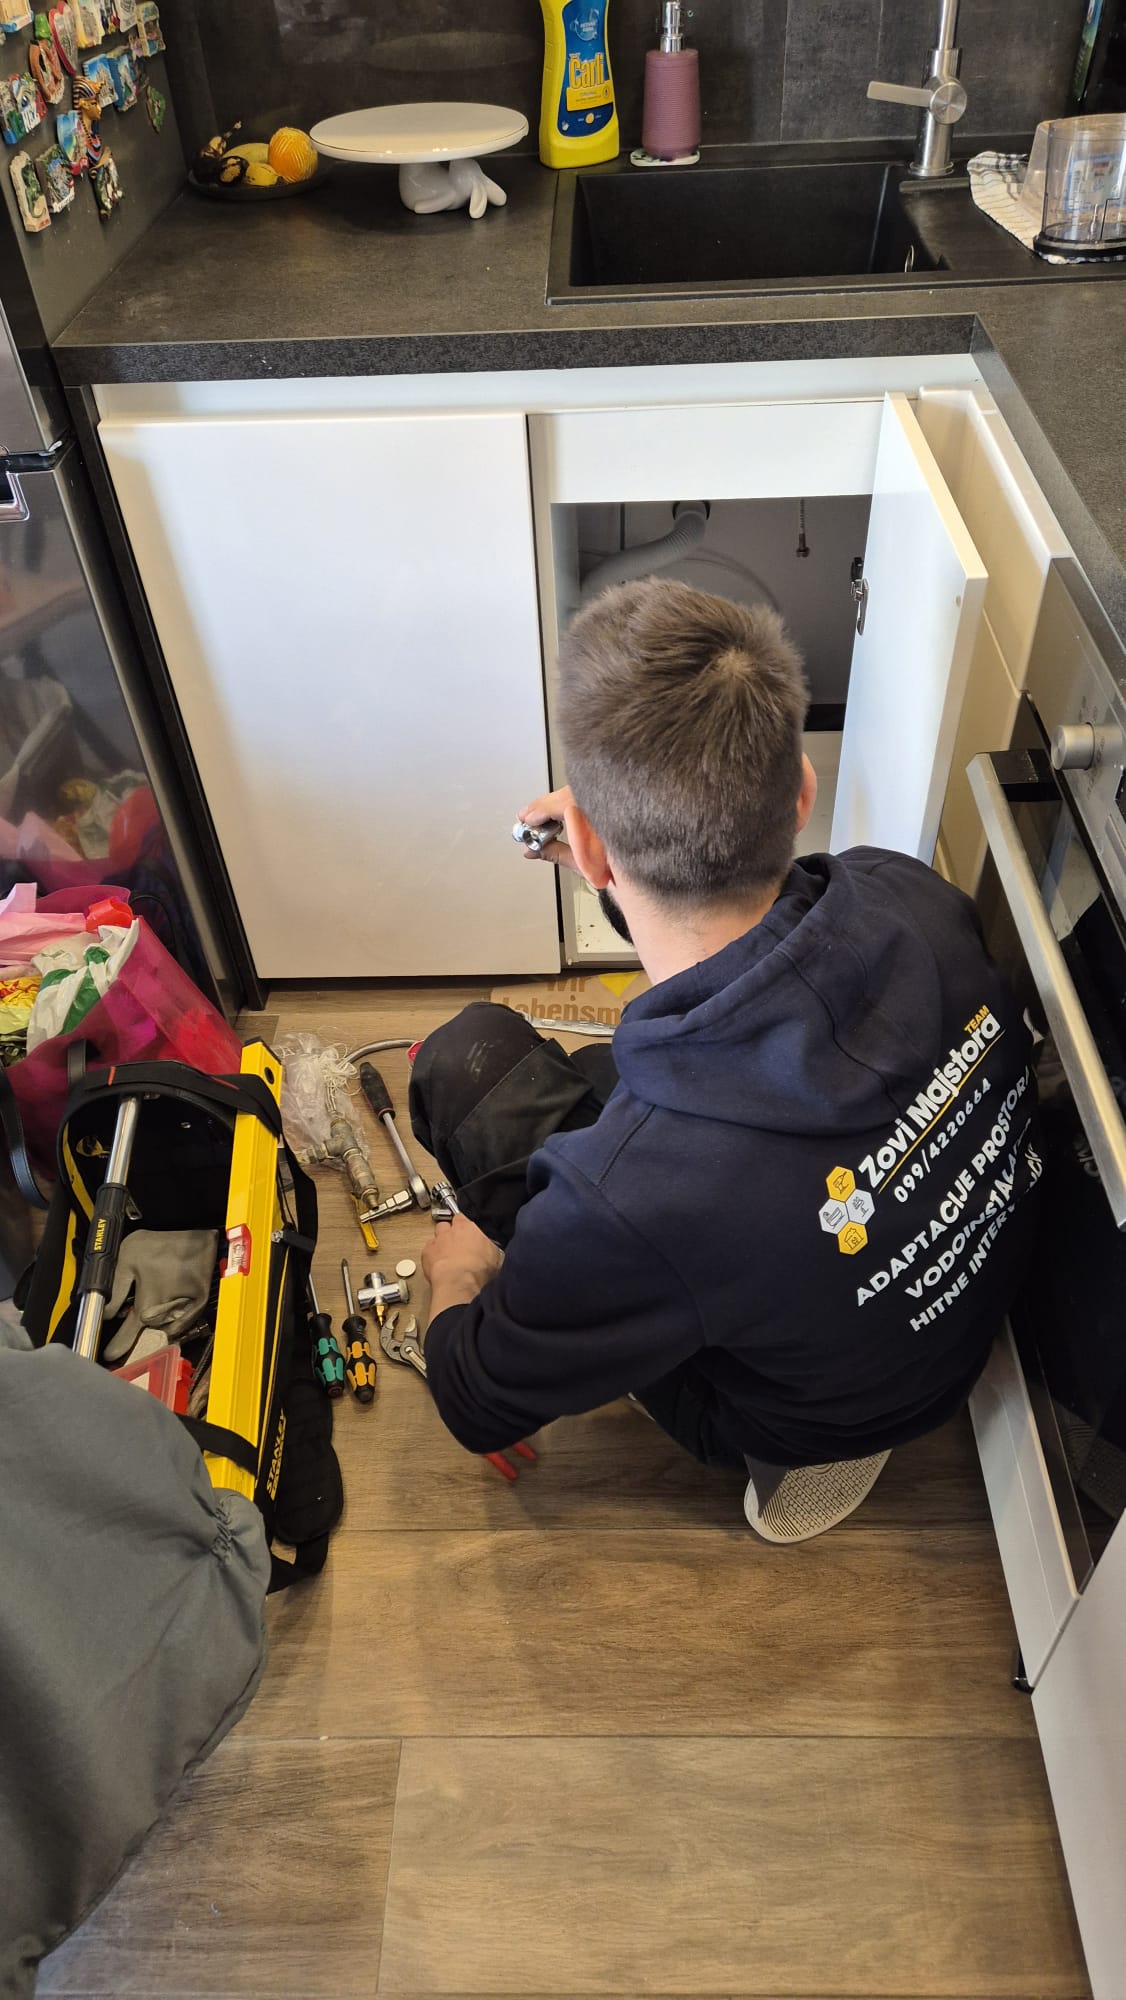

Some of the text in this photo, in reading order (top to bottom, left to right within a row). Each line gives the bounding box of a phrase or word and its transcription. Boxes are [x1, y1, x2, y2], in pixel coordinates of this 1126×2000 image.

[964, 1004, 990, 1034] TEAM
[858, 1013, 1001, 1188] Zovi Majstora
[894, 1077, 992, 1203] 099/4220664
[93, 1218, 107, 1251] STANLEY
[856, 1168, 976, 1306] ADAPTACIJE
[909, 1271, 970, 1332] HITNE
